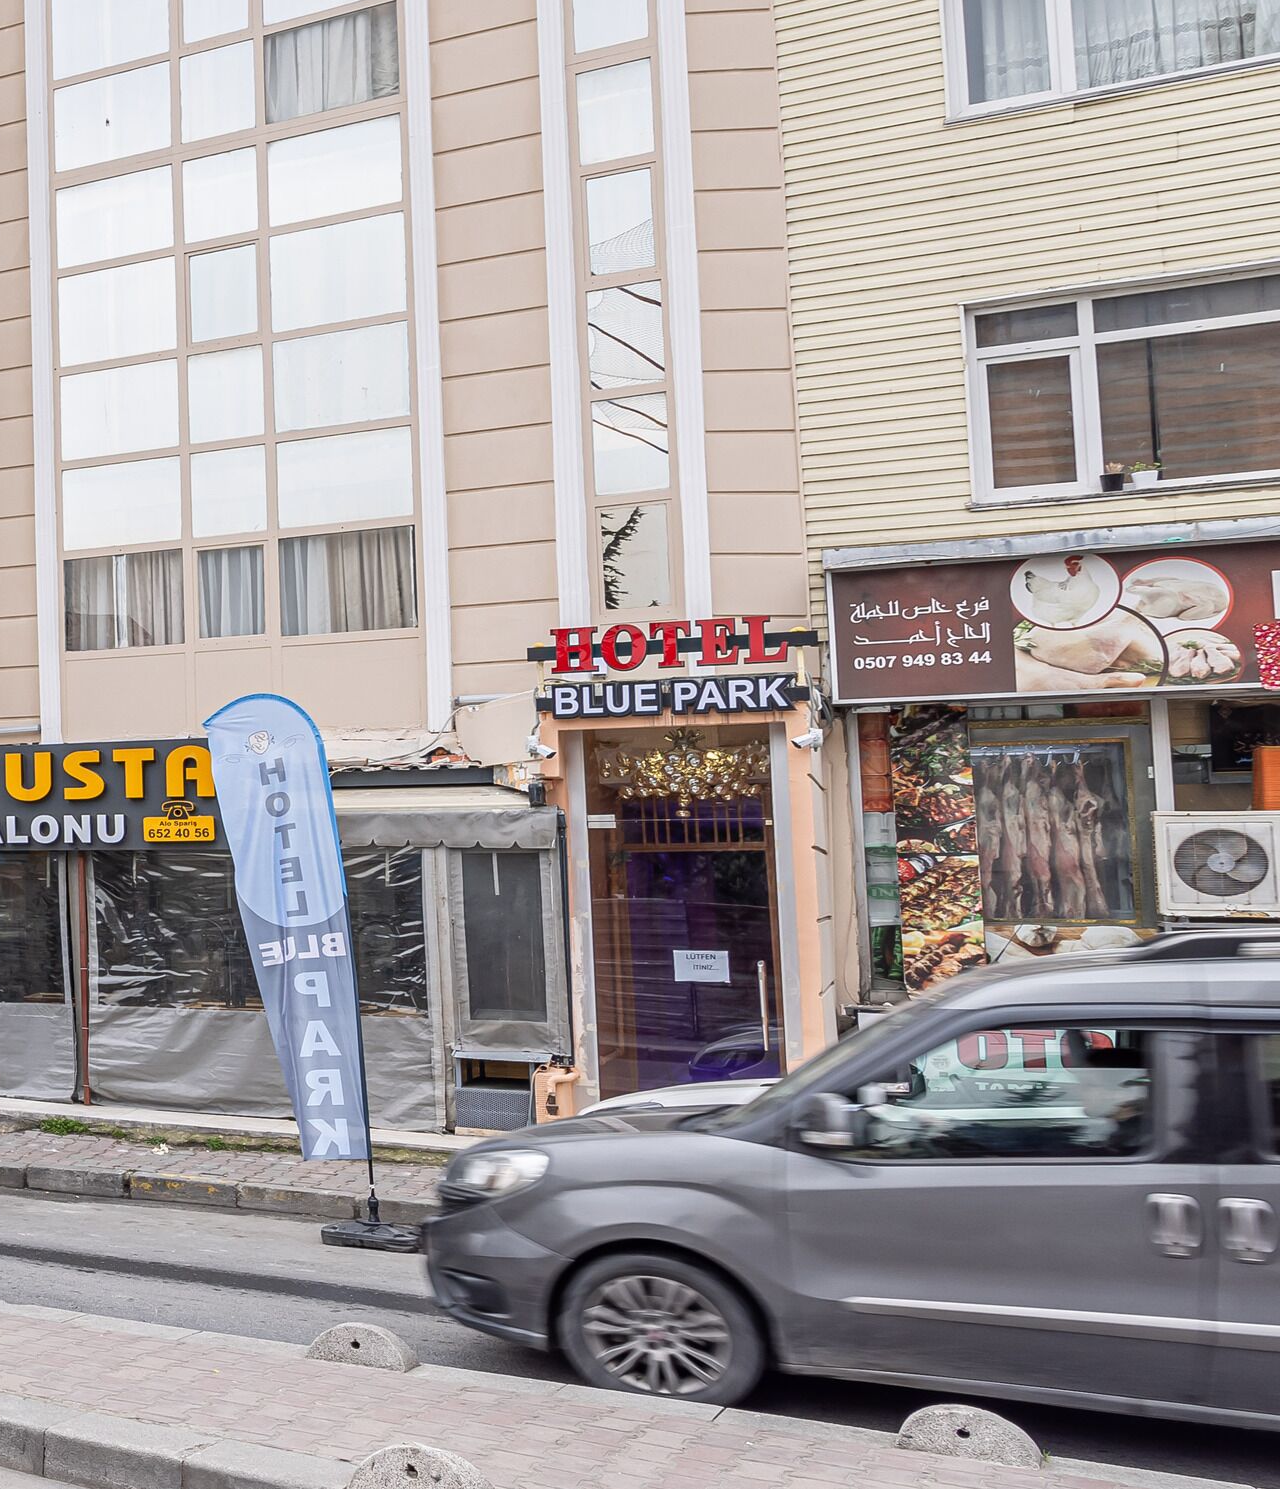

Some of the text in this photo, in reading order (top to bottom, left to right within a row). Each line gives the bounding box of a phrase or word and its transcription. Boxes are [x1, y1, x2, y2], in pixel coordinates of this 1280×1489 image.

[901, 597, 952, 620] خاص
[956, 596, 990, 619] فرع
[550, 615, 789, 674] HOTEL
[946, 621, 991, 648] الحاج
[854, 650, 992, 670] 0507 949 83 44
[555, 677, 789, 715] BLUE PARK
[4, 745, 216, 802] USTA
[148, 827, 210, 839] 652 40 56
